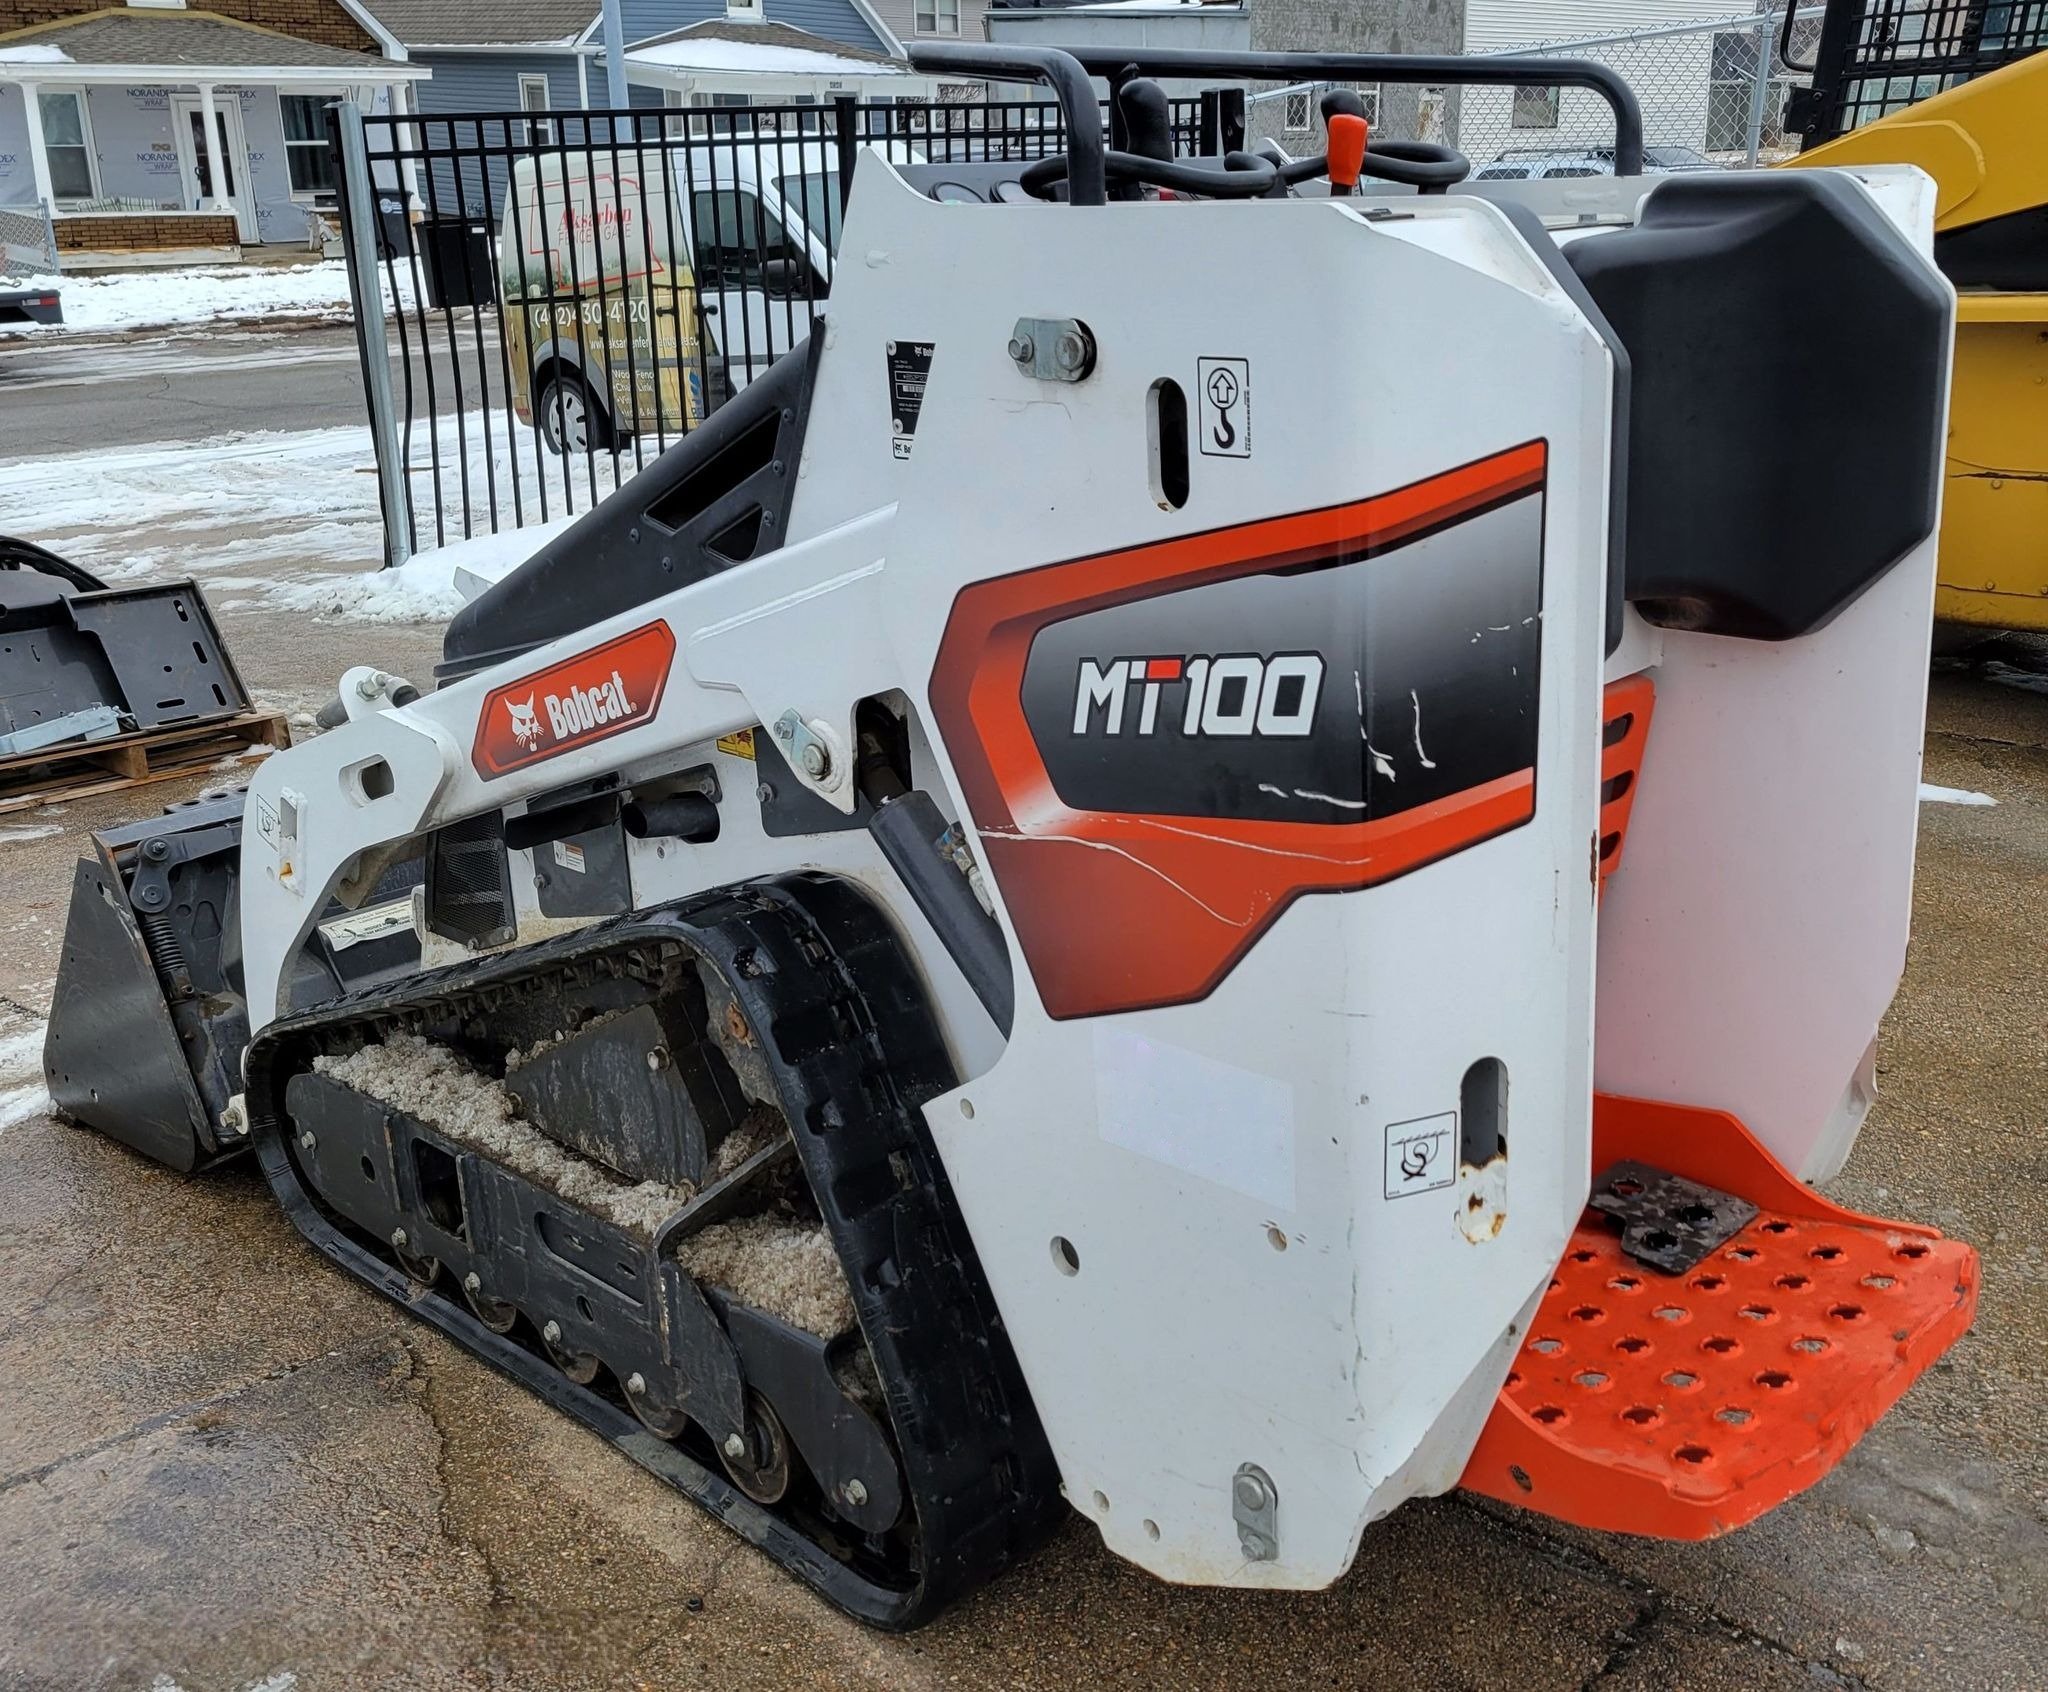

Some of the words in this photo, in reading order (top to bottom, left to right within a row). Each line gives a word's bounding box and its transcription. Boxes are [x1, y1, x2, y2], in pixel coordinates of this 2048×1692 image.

[137, 153, 178, 162] NORAND
[559, 228, 592, 246] FECE
[604, 223, 632, 241] GAE
[535, 300, 649, 329] (42)430-4120
[612, 369, 631, 379] Woo
[543, 670, 632, 741] Bobcat
[1072, 654, 1324, 737] MT100
